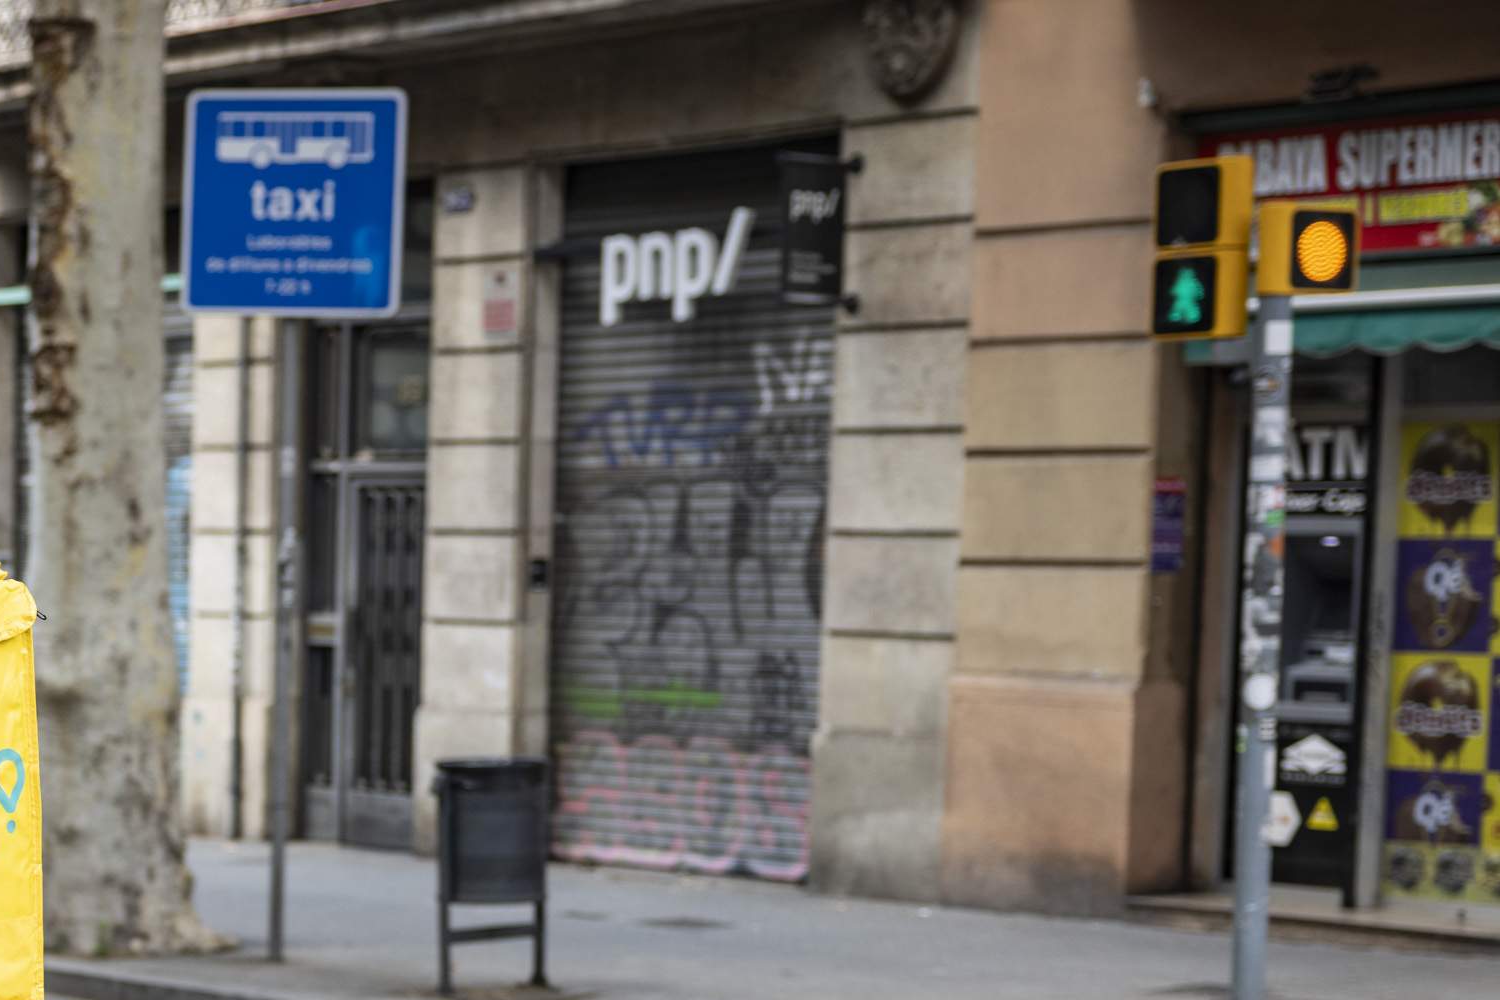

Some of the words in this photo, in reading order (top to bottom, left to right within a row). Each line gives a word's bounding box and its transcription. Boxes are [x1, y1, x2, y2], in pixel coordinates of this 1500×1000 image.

[1218, 134, 1329, 197] BAYA
[250, 179, 336, 222] taxi
[600, 206, 756, 327] pnp/
